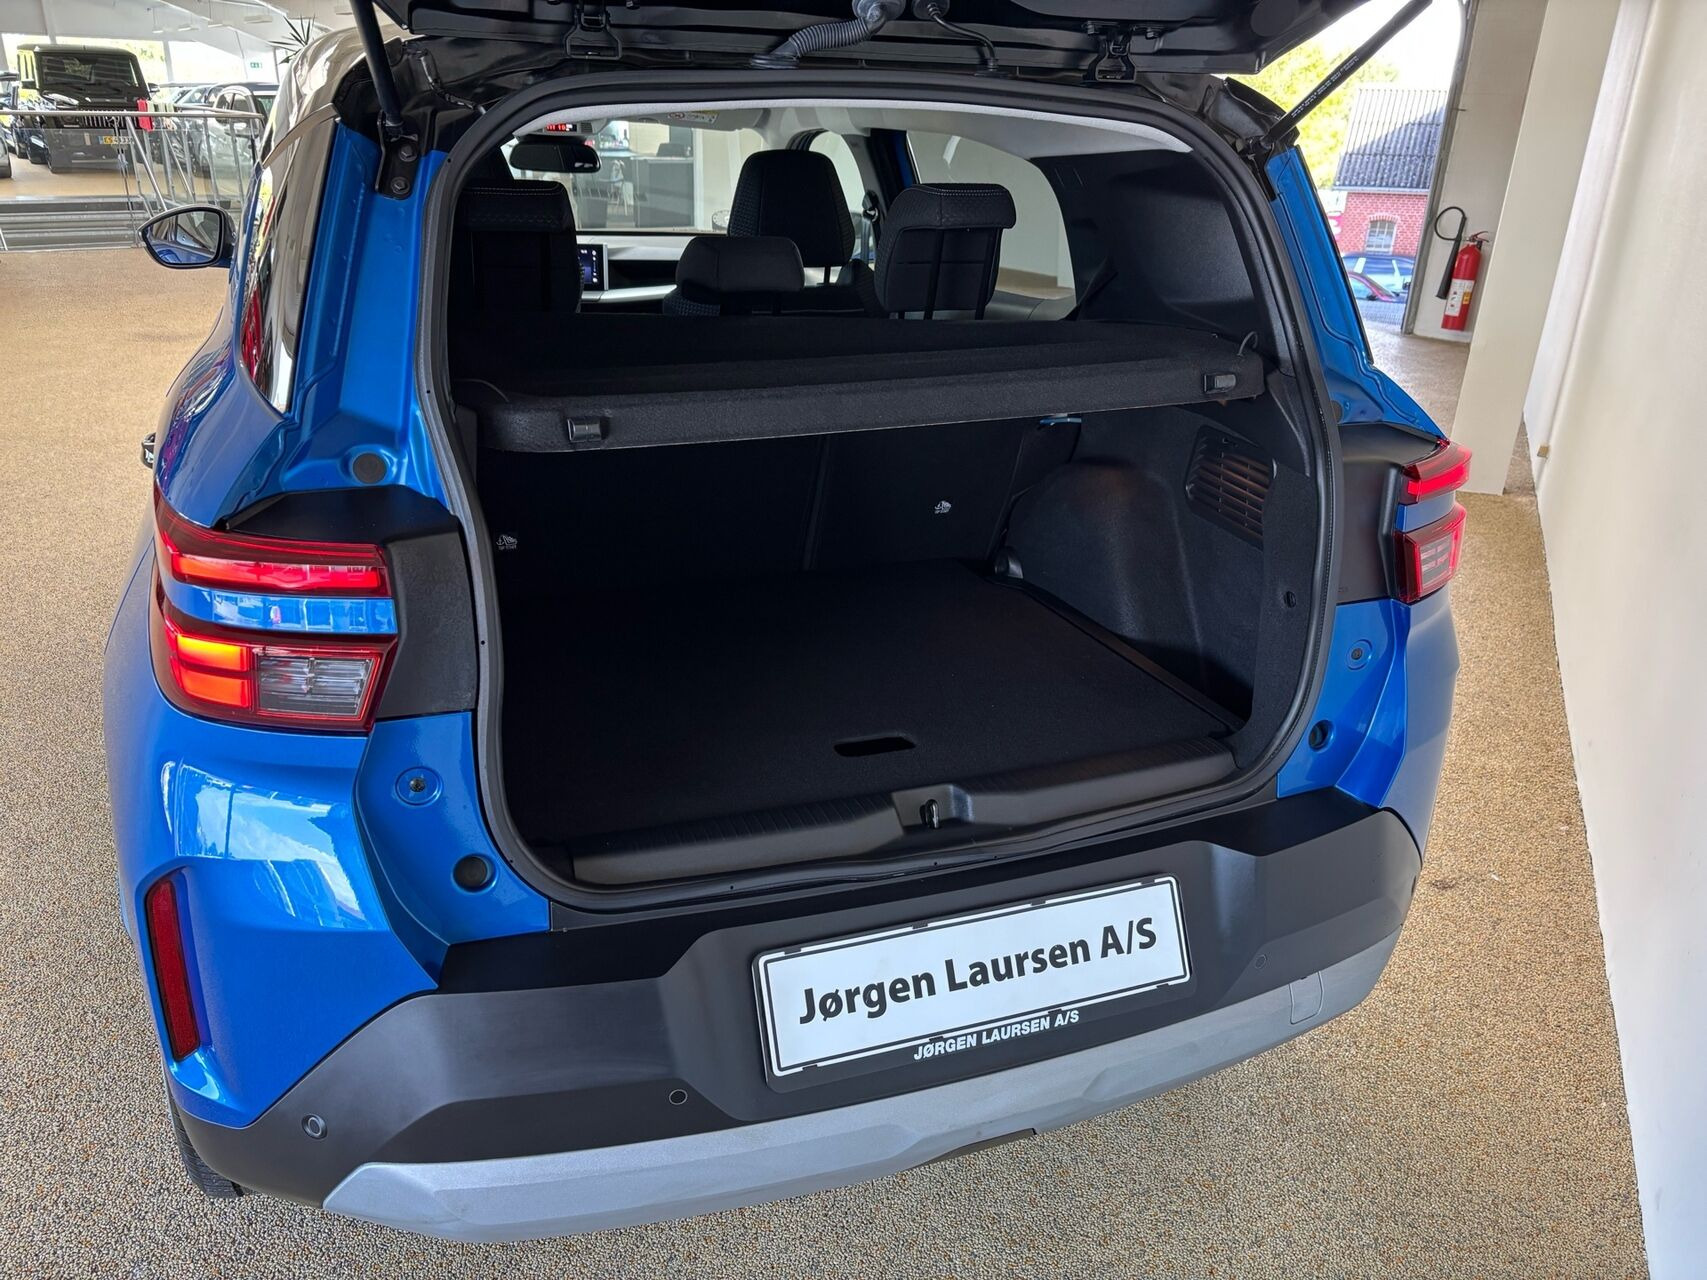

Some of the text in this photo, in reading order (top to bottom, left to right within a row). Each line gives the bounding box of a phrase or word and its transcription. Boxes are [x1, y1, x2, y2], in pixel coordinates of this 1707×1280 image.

[799, 917, 1157, 1025] Jørgen Laursen A/S
[913, 1010, 1080, 1060] JØRGEN LAURSEN A/S
